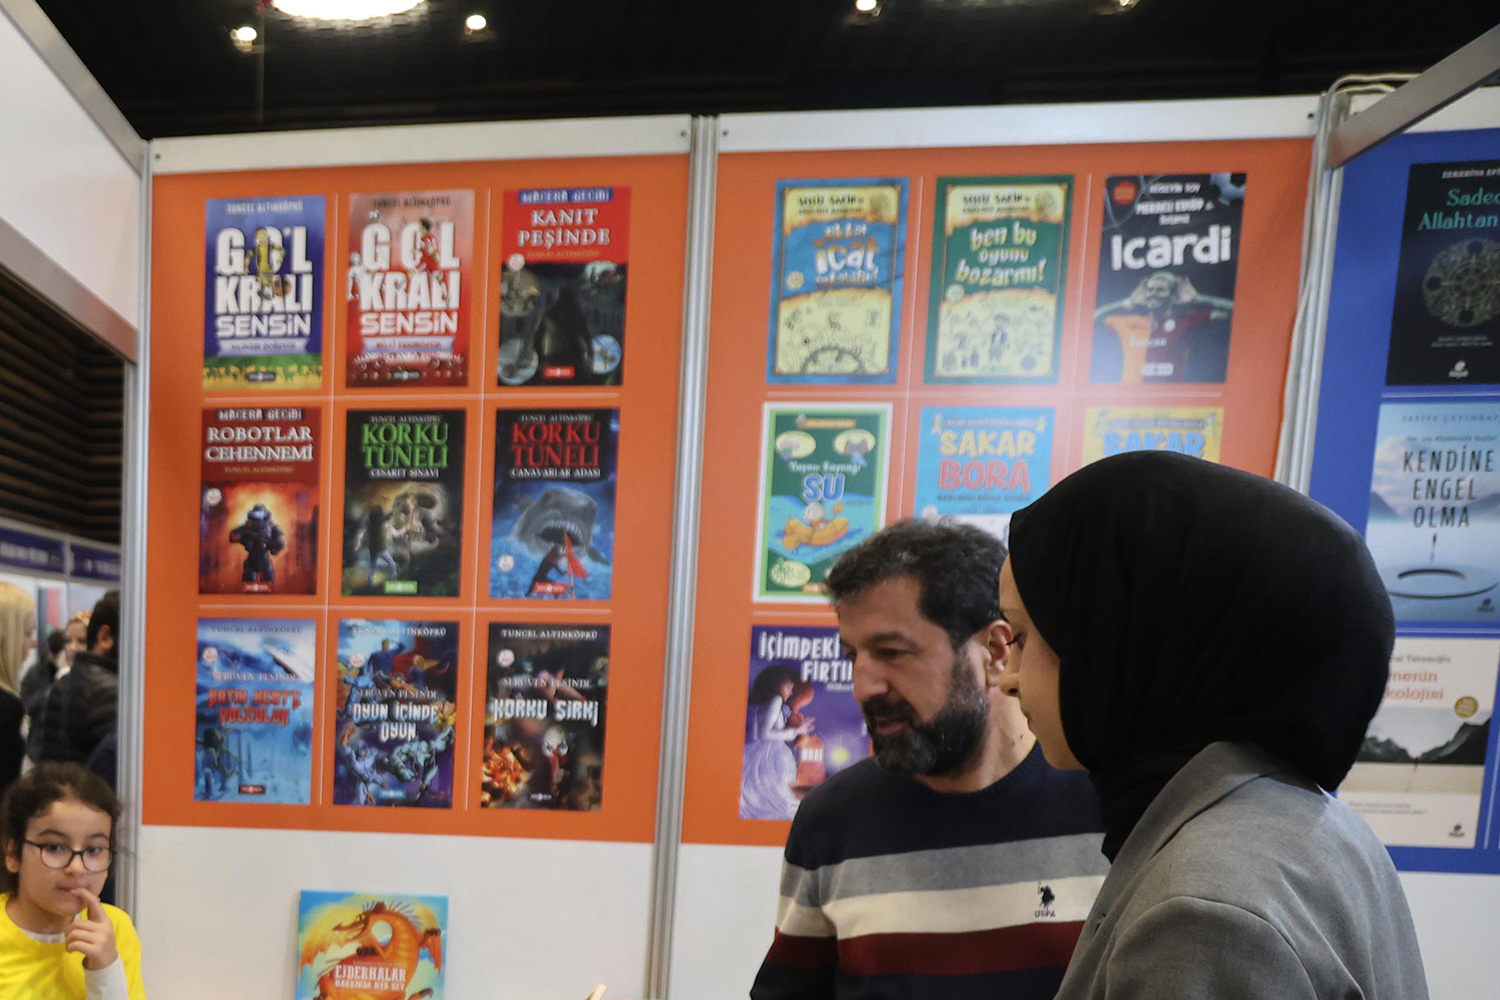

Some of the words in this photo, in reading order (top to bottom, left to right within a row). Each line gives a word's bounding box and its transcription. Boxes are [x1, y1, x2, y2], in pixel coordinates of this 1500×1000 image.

[1446, 186, 1500, 207] Sadec
[531, 207, 600, 226] KANIT
[1417, 211, 1499, 231] Allahtan
[518, 228, 611, 248] PEŞİNDE
[969, 227, 1008, 252] ben
[1012, 221, 1038, 247] bu
[1110, 226, 1233, 271] Icardi
[216, 273, 313, 315] KRALI
[360, 271, 461, 312] KRALI
[207, 426, 314, 444] ROBOTLAR
[362, 422, 449, 445] KORKU
[511, 420, 600, 444] KORKU
[938, 429, 1036, 456] SAKAR
[205, 442, 314, 463] CEHENNEMİ
[362, 443, 449, 468] TÜNELİ
[511, 443, 600, 468] TÜNELİ
[1102, 432, 1207, 458] SAKAR
[1403, 444, 1495, 473] KENDİNE
[574, 468, 601, 479] ADASI
[937, 457, 1032, 492] BORA
[803, 472, 846, 501] SU
[1413, 477, 1477, 503] ENGEL
[1412, 505, 1470, 529] OLMA
[501, 629, 538, 639] TUNCEL
[540, 629, 598, 640] ALTINKÖPRÜ
[758, 629, 842, 661] İÇİMDEKİ
[493, 699, 548, 720] KORKU
[334, 964, 407, 983] EJDERHALAR
